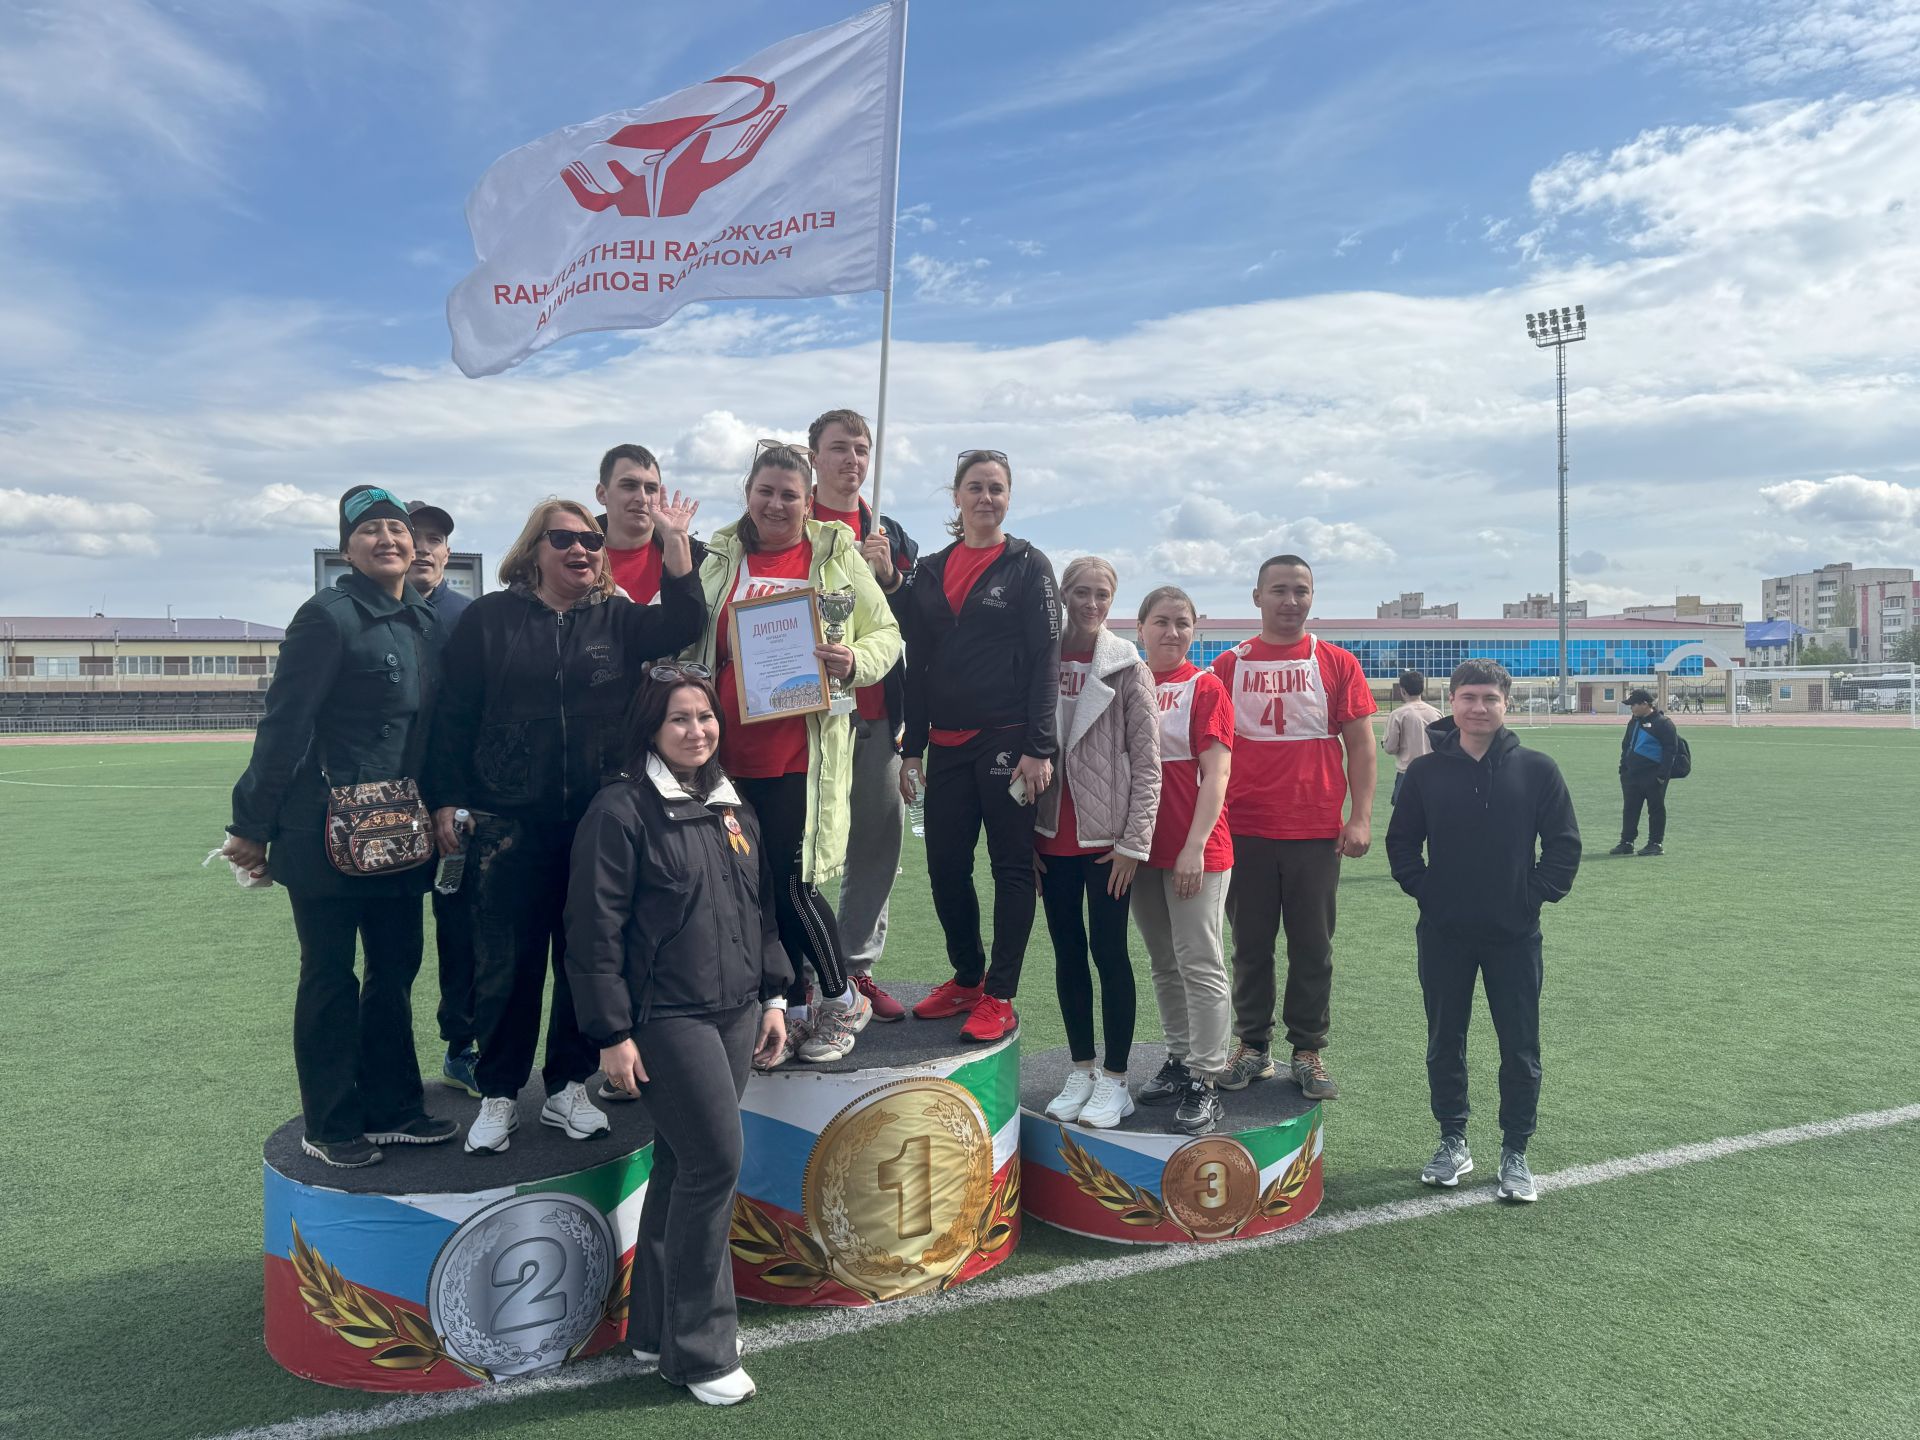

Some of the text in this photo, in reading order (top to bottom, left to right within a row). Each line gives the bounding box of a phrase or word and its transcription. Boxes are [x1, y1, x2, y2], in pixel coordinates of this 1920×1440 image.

[752, 616, 798, 638] ДИПЛОМ
[1042, 575, 1060, 641] AIR SPIRIT
[1242, 669, 1316, 694] МЕДИК
[1260, 697, 1287, 735] 4
[878, 1135, 932, 1240] 1
[1195, 1161, 1230, 1209] 3
[490, 1236, 568, 1336] 2
